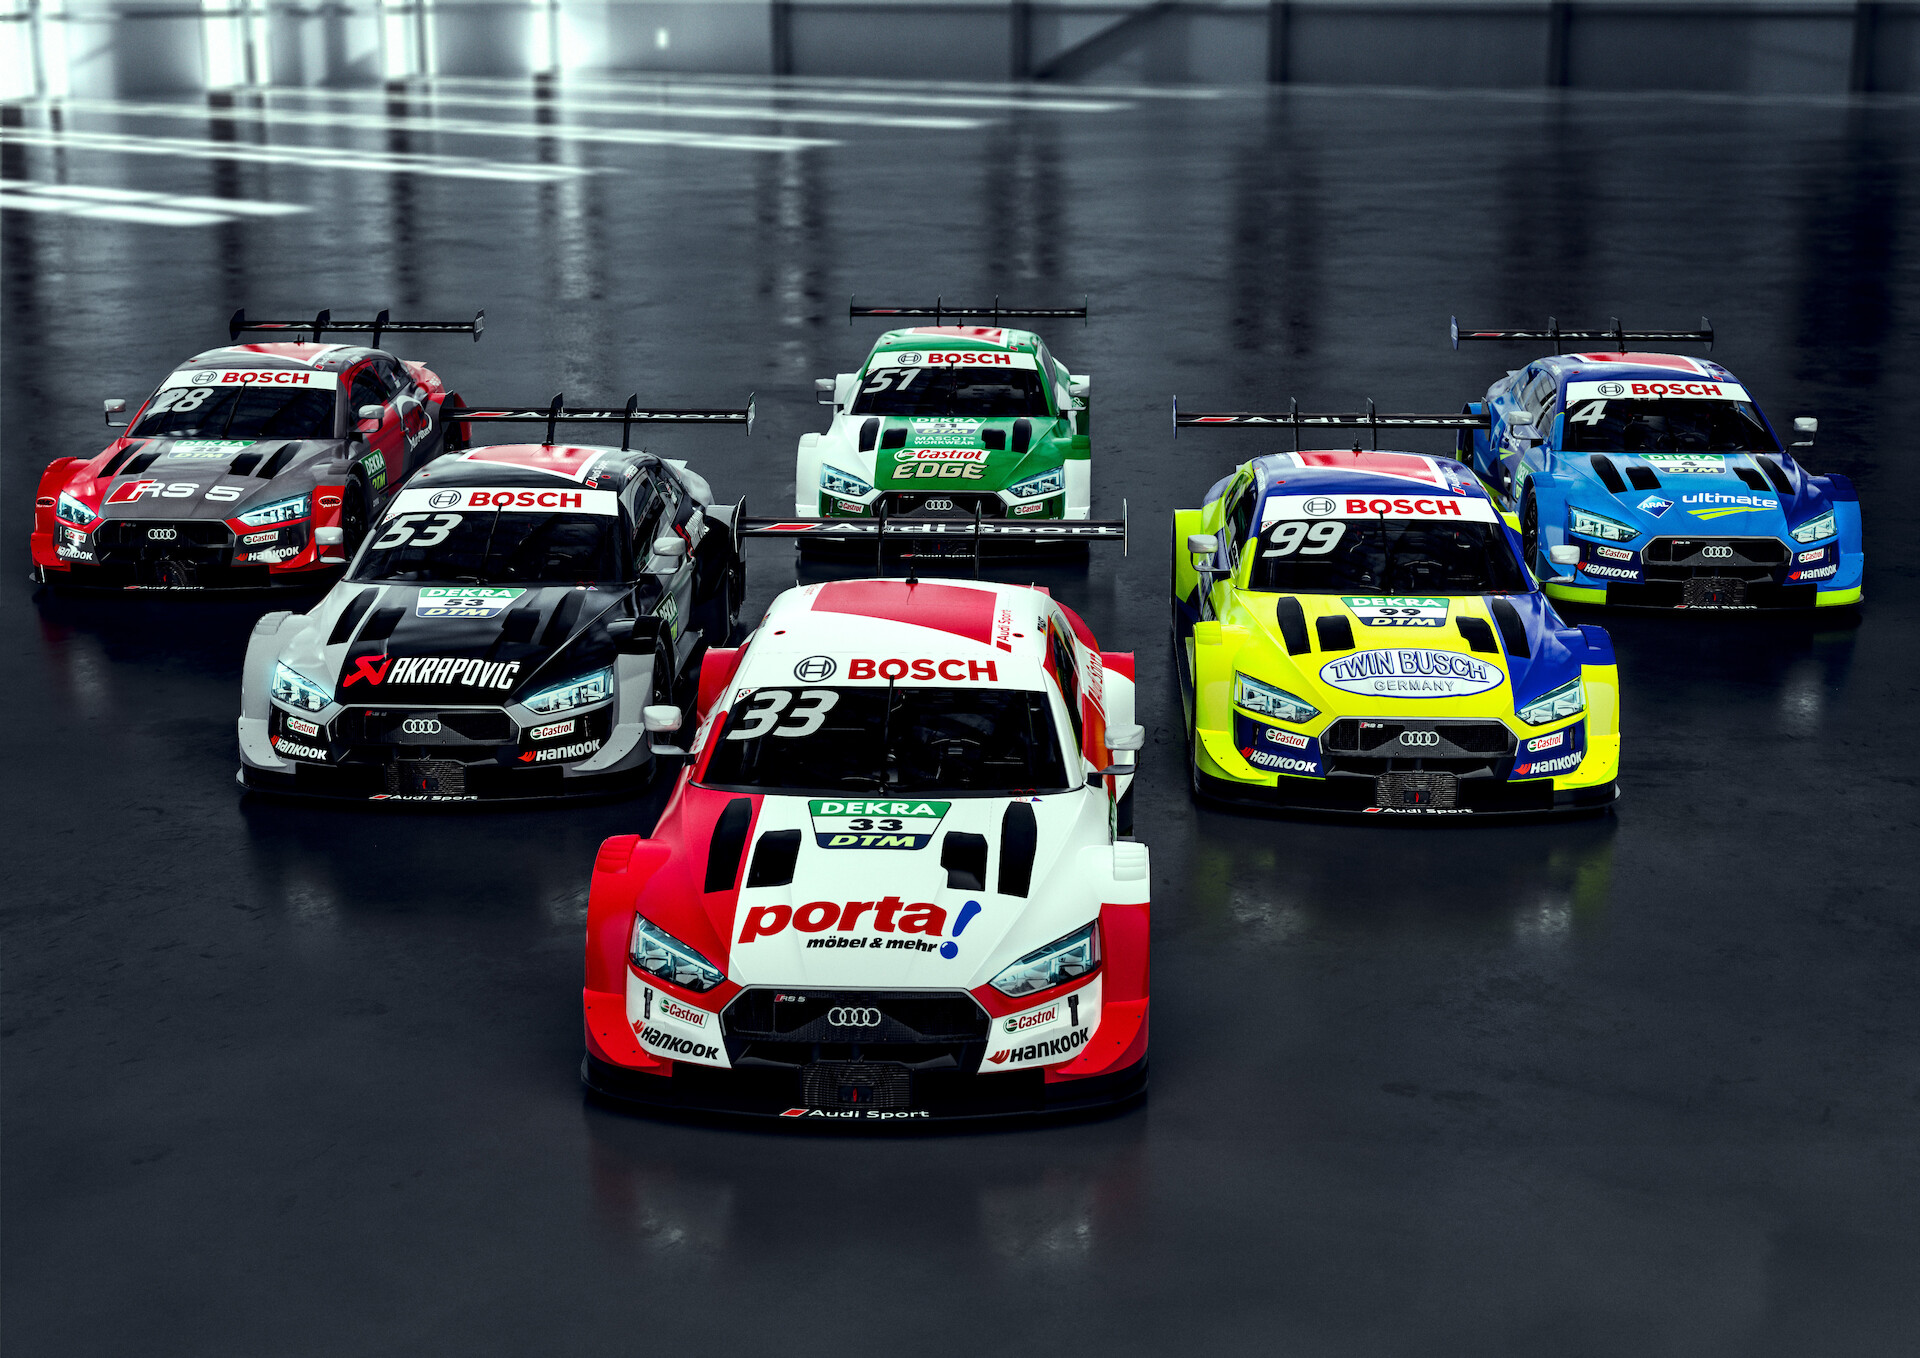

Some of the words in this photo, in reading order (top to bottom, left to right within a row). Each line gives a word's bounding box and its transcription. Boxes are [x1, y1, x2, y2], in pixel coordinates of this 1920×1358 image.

[927, 353, 1011, 365] BOSCH
[221, 372, 310, 384] BOSCH
[862, 368, 922, 394] 51
[1631, 383, 1723, 396] BOSCH
[145, 387, 214, 420] 28
[1569, 400, 1608, 426] 4
[917, 449, 983, 461] Castrol
[364, 451, 386, 477] DEKRA
[891, 462, 990, 479] EDGE
[127, 482, 200, 500] RS
[205, 485, 245, 502] 5
[468, 491, 582, 508] BOSCH
[1346, 498, 1462, 516] BOSCH
[1641, 501, 1669, 510] ARAL
[1682, 492, 1778, 508] ultimate
[1021, 503, 1042, 514] Castrol
[252, 533, 277, 543] Castrol
[371, 513, 464, 550] 53
[1261, 521, 1347, 557] 99
[1605, 548, 1630, 560] Castrol
[1805, 550, 1823, 561] Castrol
[426, 588, 512, 598] DEKRA
[443, 599, 485, 607] 53
[1351, 597, 1442, 607] DEKRA
[423, 607, 491, 617] DTM
[1378, 608, 1422, 616] 99
[1370, 617, 1436, 626] DTM
[848, 658, 999, 682] BOSCH
[1329, 651, 1394, 679] TWIN
[1400, 650, 1488, 681] BUSCH
[1373, 679, 1455, 692] GERMANY
[725, 689, 840, 740] 33
[293, 719, 317, 735] Castrol
[541, 722, 573, 737] Castrol
[1274, 731, 1307, 747] Castrol
[1536, 734, 1562, 749] Castrol
[431, 794, 478, 802] Sport
[820, 802, 937, 816] DEKRA
[848, 818, 904, 832] 33
[827, 834, 916, 848] DTM
[737, 895, 982, 960] porta!
[806, 935, 868, 949] möbel
[869, 937, 883, 949] &
[885, 937, 938, 953] mehr
[669, 1002, 704, 1026] Castrol
[1018, 1007, 1056, 1030] Castrol
[808, 1109, 860, 1118] Audi
[866, 1109, 930, 1120] Sport
